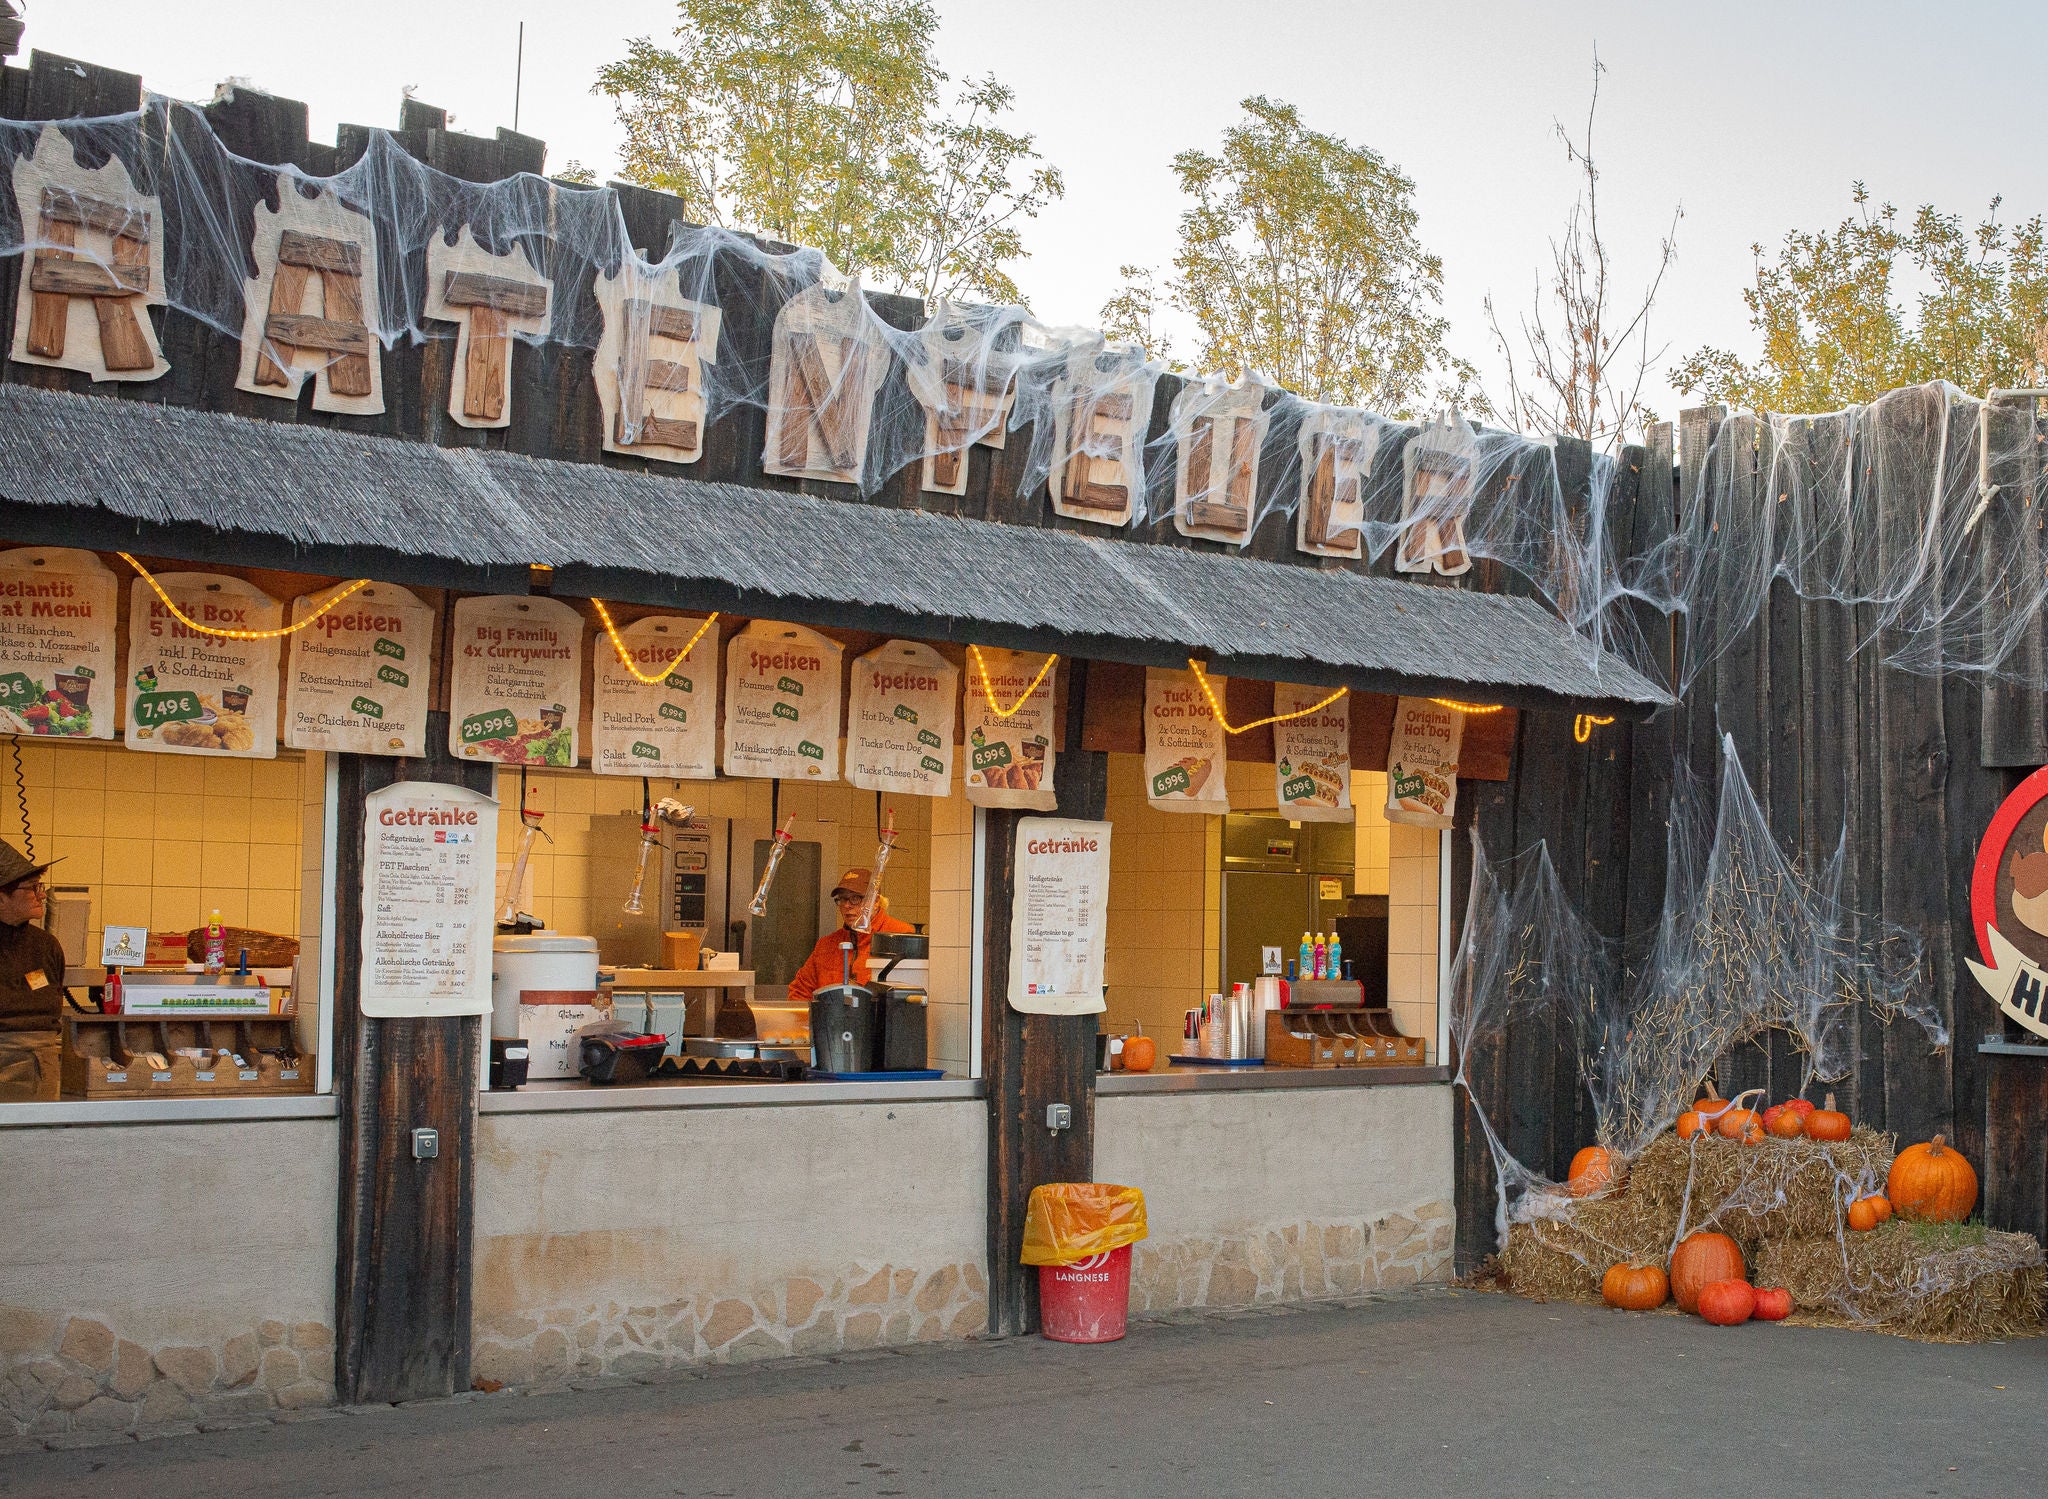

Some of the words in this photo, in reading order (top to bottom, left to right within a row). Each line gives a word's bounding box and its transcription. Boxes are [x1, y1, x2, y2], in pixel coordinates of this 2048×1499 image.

[0, 601, 23, 617] at
[31, 602, 91, 618] Menü
[204, 604, 246, 622] Box
[0, 623, 13, 634] kl.
[17, 623, 76, 638] Hähnchen,
[149, 620, 163, 637] 5
[316, 611, 402, 638] Speisen
[477, 627, 502, 645] Big
[507, 627, 558, 647] Family
[27, 640, 37, 649] o.
[40, 638, 100, 653] Mozzarella
[302, 640, 370, 658] Beilagensalat
[1, 650, 10, 660] &
[13, 650, 65, 664] Softdrink
[159, 646, 187, 659] inkl.
[192, 647, 246, 666] Pommes
[463, 645, 482, 657] 4x
[487, 645, 571, 664] Currywurst
[487, 663, 505, 674] inkl.
[508, 664, 546, 677] Pommes,
[750, 651, 821, 675] Speisen
[158, 661, 169, 674] &
[172, 662, 234, 682] Softdrink
[299, 672, 373, 689] Röstischnitzel
[487, 674, 545, 688] Salatgarnitur
[739, 678, 774, 691] Pommes
[873, 671, 938, 695] Speisen
[0, 680, 25, 698] 9€
[483, 687, 491, 696] &
[493, 687, 505, 697] 4x
[506, 688, 547, 700] Softdrink
[603, 711, 633, 724] Pulled
[634, 713, 656, 725] Pork
[737, 706, 771, 719] Wedges
[861, 710, 876, 721] Hot
[879, 712, 895, 725] Dog
[1153, 705, 1184, 718] Corn
[1188, 704, 1214, 721] Dog
[1406, 710, 1451, 728] Original
[297, 712, 315, 723] 9er
[317, 713, 360, 727] Chicken
[362, 717, 405, 732] Nuggets
[983, 716, 991, 727] &
[992, 716, 1033, 730] Softdrink
[1321, 716, 1345, 732] Dog
[1158, 724, 1168, 735] 2x
[1169, 724, 1190, 735] Corn
[1191, 725, 1207, 738] Dog
[1404, 724, 1425, 736] Hot
[1428, 725, 1451, 742] Dog
[859, 737, 883, 748] Tucks
[884, 740, 905, 751] Corn
[906, 742, 922, 754] Dog
[1158, 737, 1165, 747] &
[1167, 737, 1204, 749] Softdrink
[1286, 732, 1295, 743] 2x
[1296, 733, 1322, 745] Cheese
[1323, 736, 1339, 749] Dog
[1403, 740, 1412, 751] 2x
[1414, 742, 1426, 753] Hot
[1427, 744, 1441, 757] Dog
[603, 749, 626, 760] Salat
[734, 742, 796, 757] Minikartoffeln
[1285, 745, 1292, 755] &
[1294, 746, 1328, 757] Softdrink
[858, 764, 881, 776] Tucks
[883, 766, 912, 778] Cheese
[912, 769, 929, 781] Dog
[379, 807, 478, 826] Getränke
[380, 832, 425, 844] Softgetränke
[1028, 836, 1098, 854] Getränke
[379, 861, 396, 870] PET
[376, 931, 423, 940] Alkoholfreies
[424, 931, 440, 940] Bier
[375, 957, 421, 966] Alkoholische
[422, 958, 455, 967] Getränke
[565, 1024, 576, 1034] ode
[1056, 1271, 1109, 1283] LANGNESE
